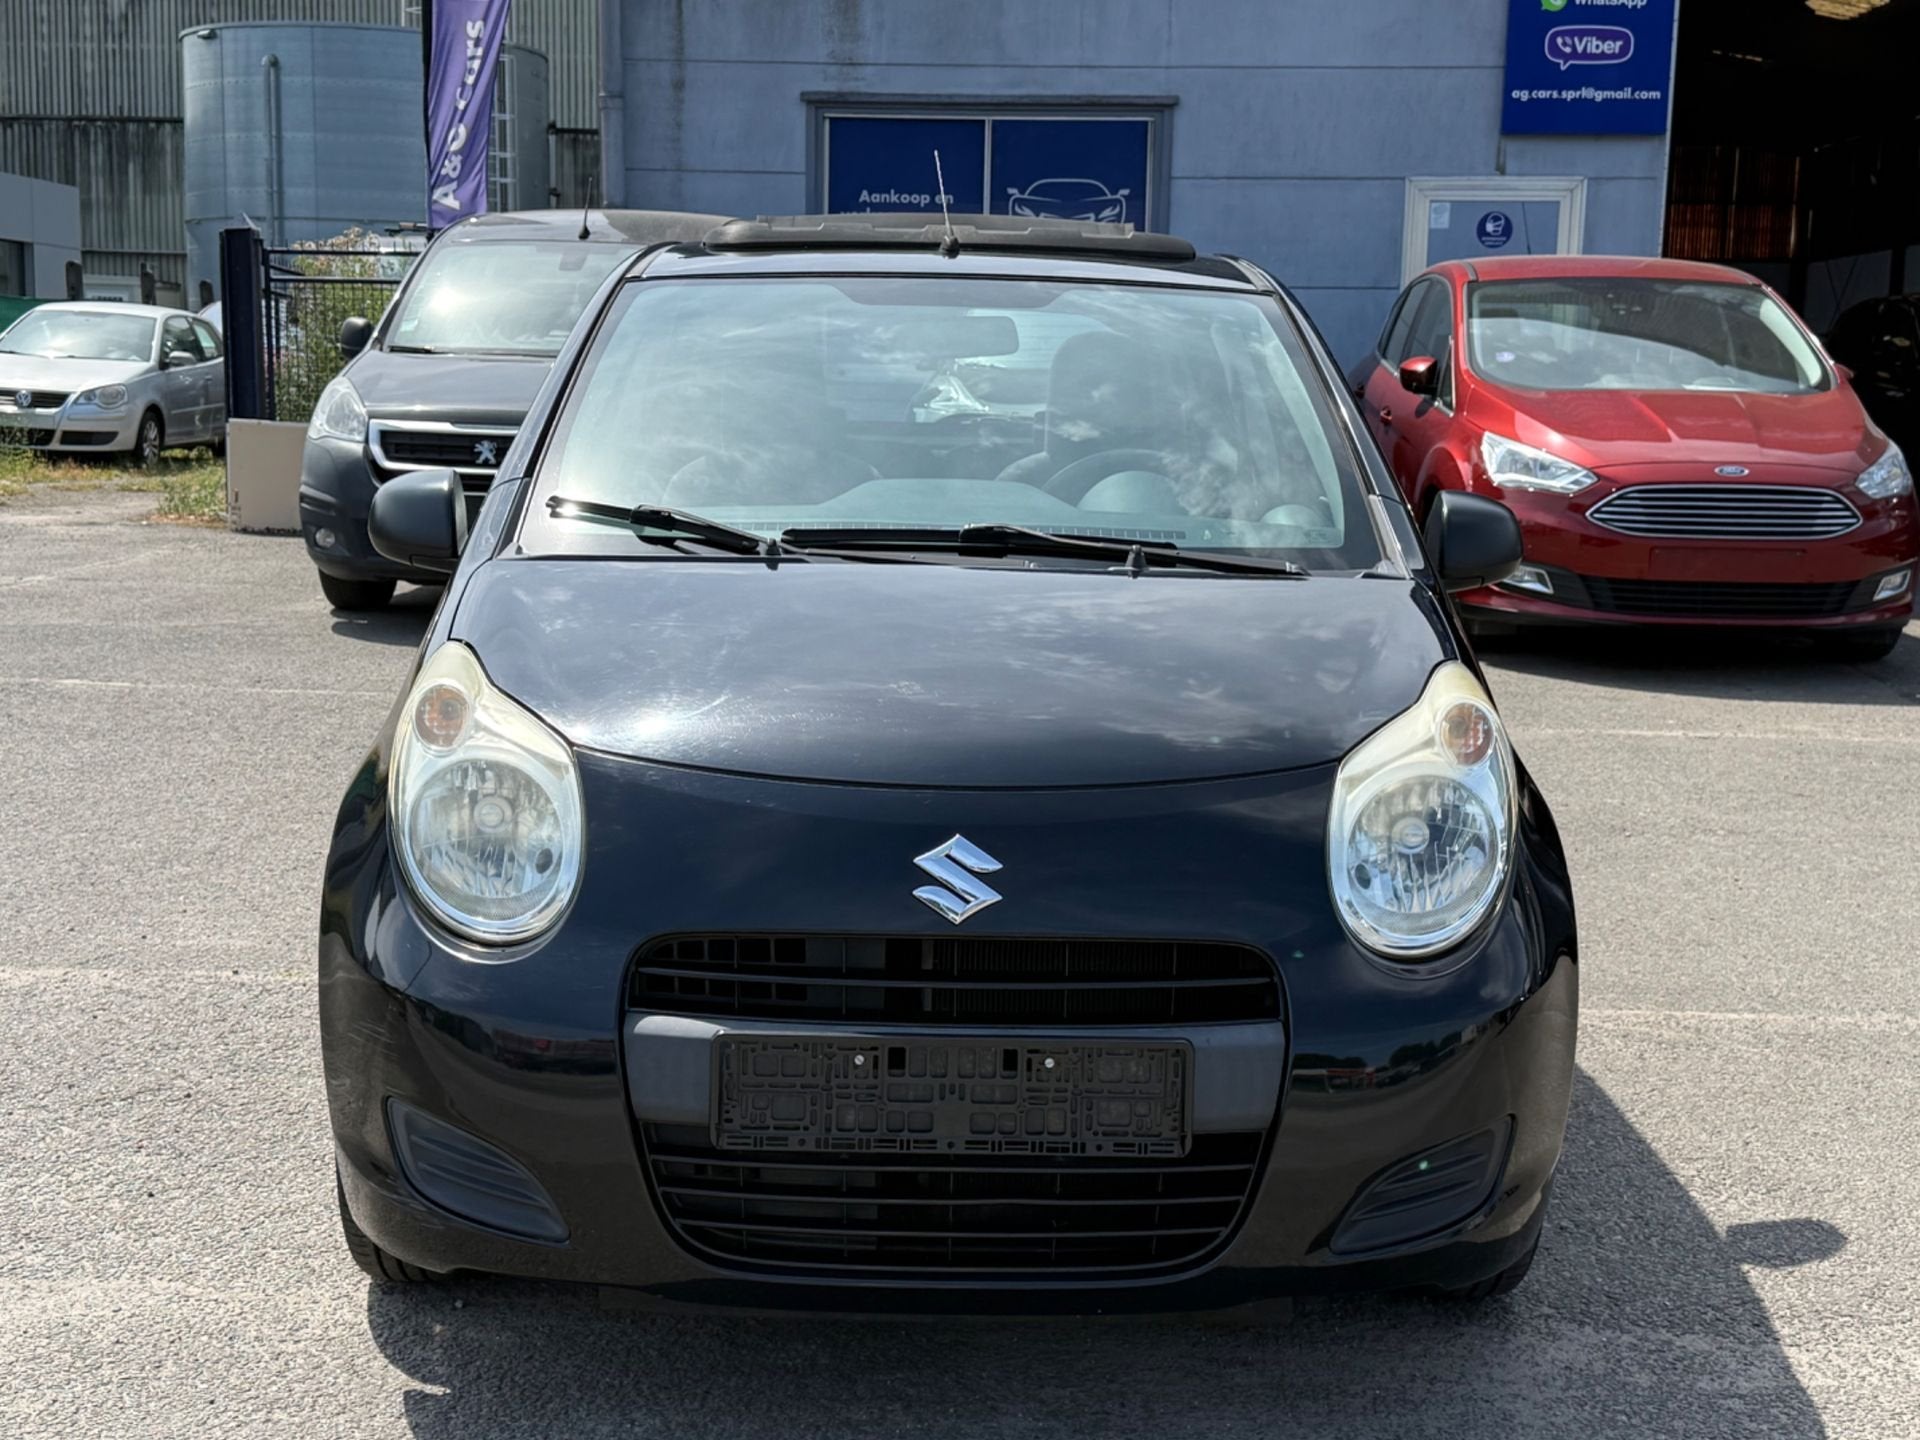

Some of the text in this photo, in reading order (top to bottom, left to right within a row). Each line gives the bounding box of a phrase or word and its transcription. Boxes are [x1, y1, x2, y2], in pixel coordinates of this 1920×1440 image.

[1573, 36, 1624, 54] Viber
[1511, 87, 1661, 102] ag.cars.sprl@gmail.com
[858, 188, 931, 208] Aankoop
